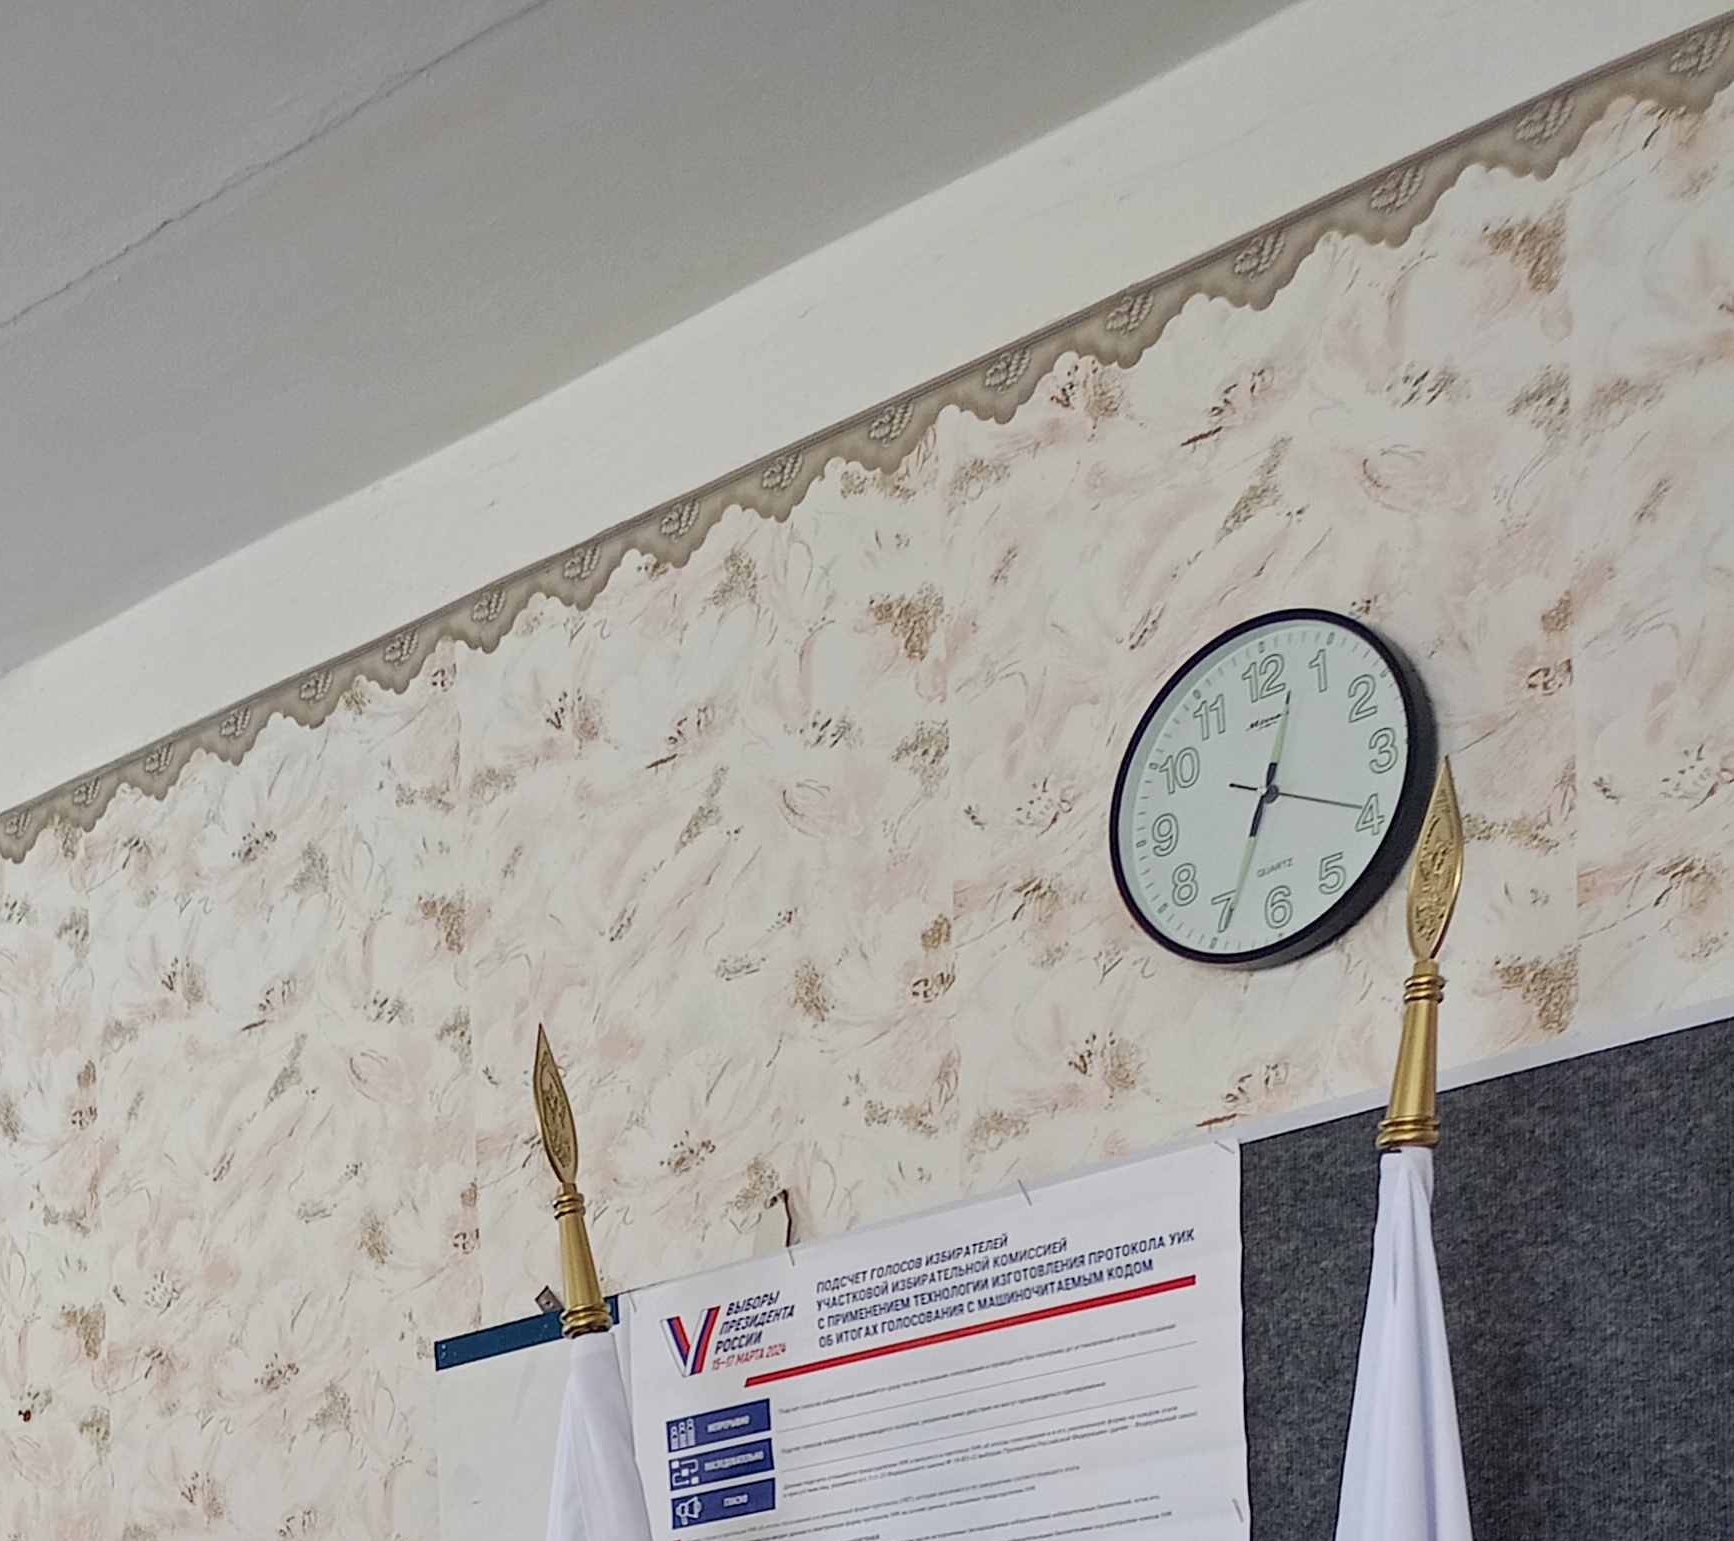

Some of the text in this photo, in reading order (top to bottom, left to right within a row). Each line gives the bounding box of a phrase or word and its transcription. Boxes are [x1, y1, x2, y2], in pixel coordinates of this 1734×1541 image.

[1242, 653, 1286, 703] 12
[1309, 649, 1327, 692] 1
[1193, 694, 1226, 740] 11
[1349, 674, 1376, 722] 2
[1159, 746, 1201, 794] 10
[1368, 727, 1397, 773] 3
[1152, 813, 1178, 857] 9
[1355, 794, 1385, 836] 4
[1171, 863, 1198, 906] 8
[1319, 853, 1346, 895] 5
[1211, 890, 1237, 933] 7
[1264, 885, 1293, 929] 6
[816, 1237, 1068, 1311] УЧАСТКОВОЙ ИЗБИРАТЕЛЬНОЙ КОМИССИЕЙ
[817, 1233, 1008, 1294] ПОДСЧЕТ ГОЛОСОВ ИЗБИРАТЕЛЕЙ
[817, 1227, 1195, 1330] С ПРИМЕНЕНИЕМ ТЕХНОЛОГИИ ИЗГОТОВЛЕНИЯ ПРОТОКОЛА УИК
[719, 1304, 795, 1335] ПРЕЗИДЕНТА
[726, 1291, 780, 1316] ВЫБОРЫ
[818, 1258, 1154, 1348] ОБ ИТОГАХ ГОЛОСОВАНИЯ С МАШИНОЧИТАЕМЫМ КОДОМ
[714, 1331, 763, 1355] РОССИИ
[735, 1348, 764, 1365] МАРТА
[766, 1342, 787, 1358] 2024
